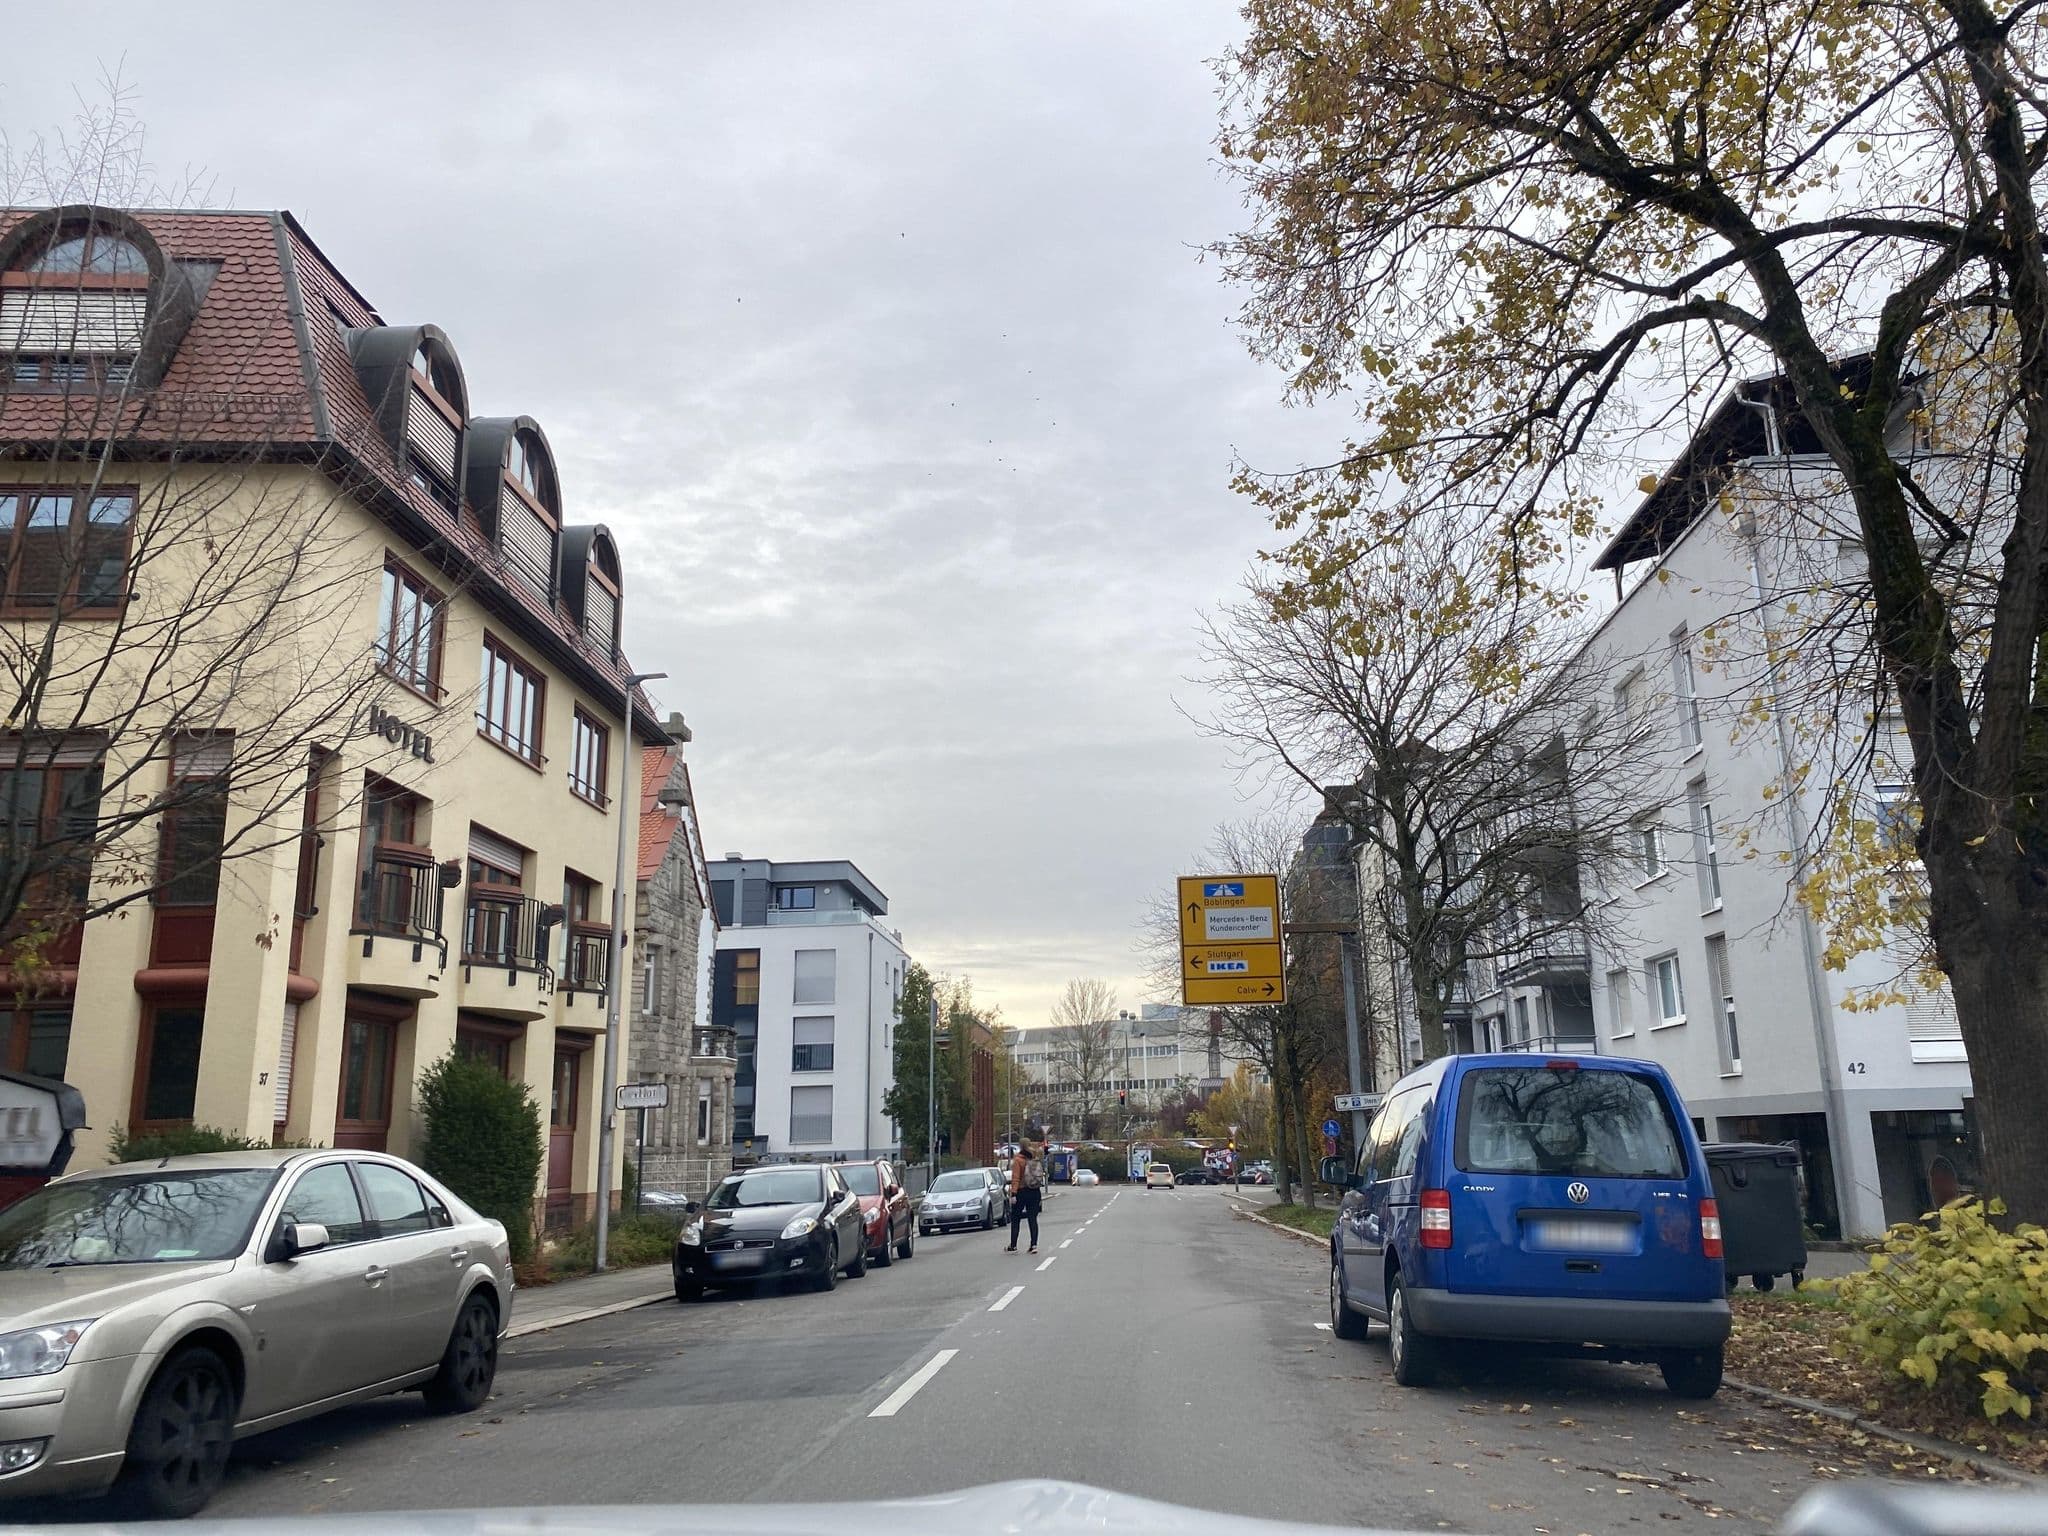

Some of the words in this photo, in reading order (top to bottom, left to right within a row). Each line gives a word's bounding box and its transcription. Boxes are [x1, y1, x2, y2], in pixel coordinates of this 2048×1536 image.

[369, 704, 435, 764] HOTEL
[1208, 950, 1243, 959] Stuttgart
[1210, 962, 1245, 970] IKEA
[1237, 986, 1257, 994] Calw
[1847, 1062, 1866, 1074] 42
[259, 1072, 269, 1085] 37
